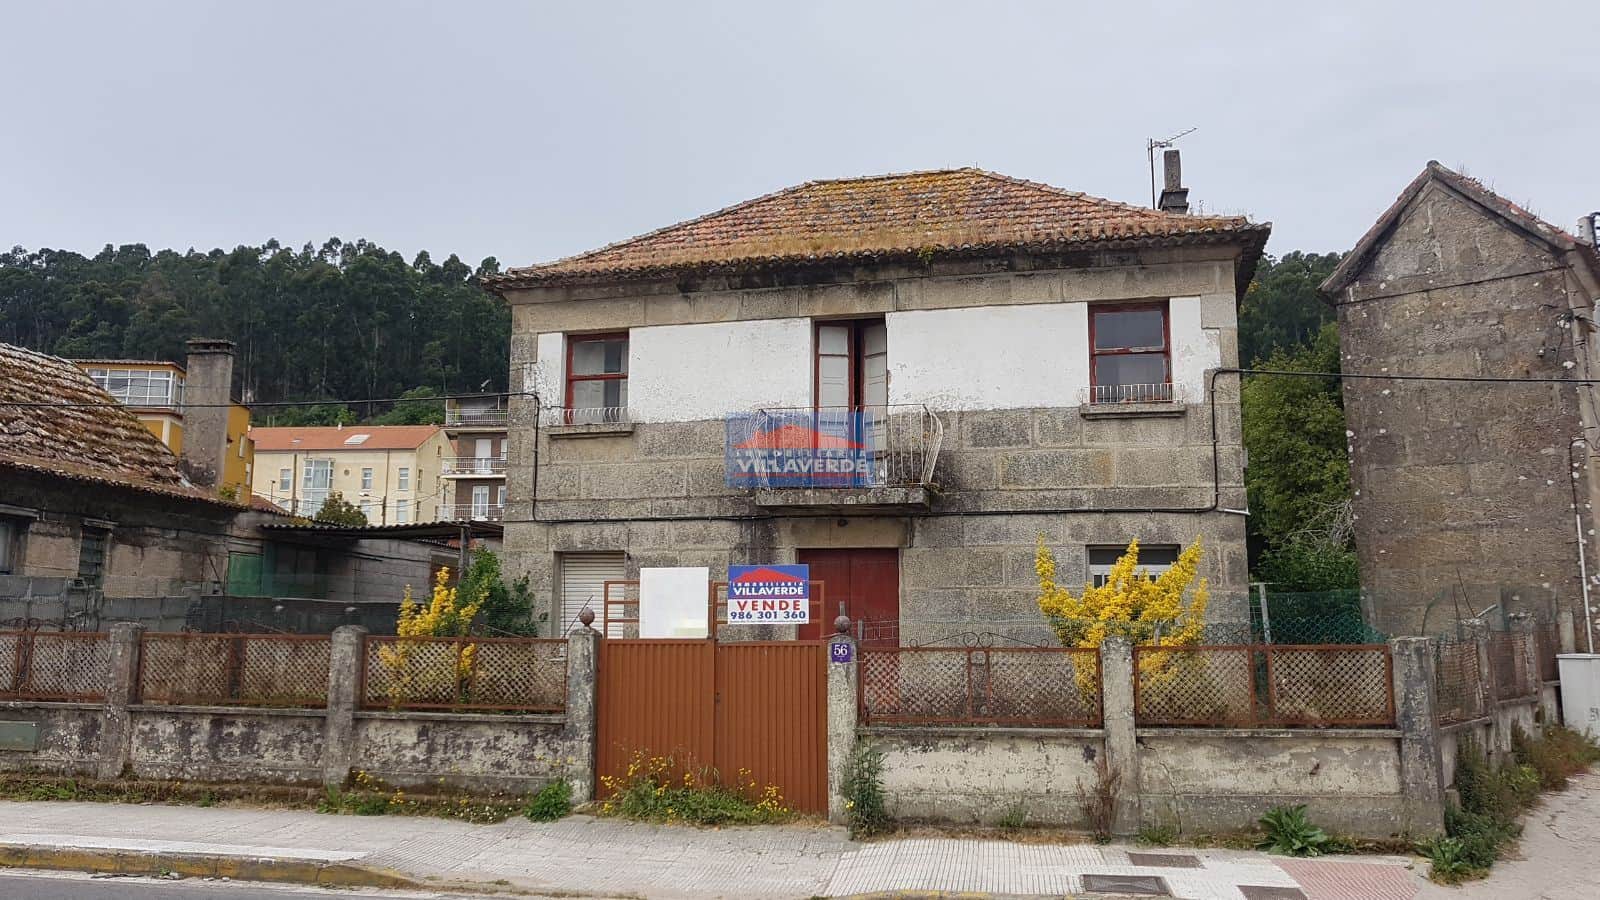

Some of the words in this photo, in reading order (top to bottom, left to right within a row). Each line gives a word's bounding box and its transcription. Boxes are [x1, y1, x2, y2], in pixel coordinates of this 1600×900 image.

[733, 587, 804, 595] VILLAVERDE
[737, 600, 801, 611] VENDE
[730, 611, 753, 620] 986
[757, 611, 777, 620] 301
[783, 611, 806, 620] 360
[834, 644, 848, 656] 56
